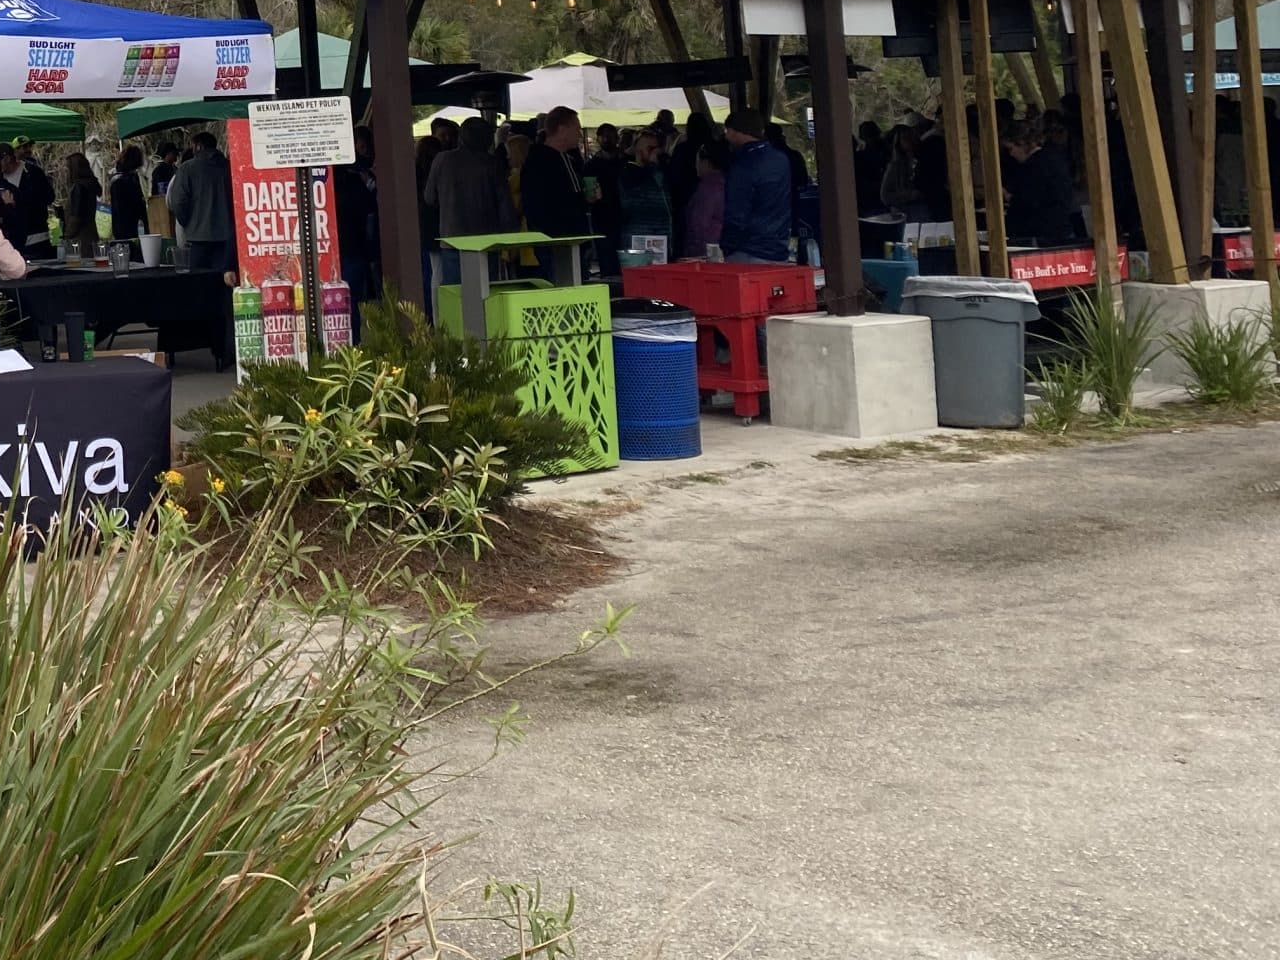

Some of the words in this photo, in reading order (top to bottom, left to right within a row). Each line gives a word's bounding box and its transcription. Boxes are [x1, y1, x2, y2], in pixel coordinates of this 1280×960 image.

[29, 40, 48, 48] BUD
[49, 41, 76, 50] LIGHT
[27, 49, 74, 68] SELTZER
[216, 46, 251, 65] SELTZER
[27, 68, 69, 82] HARD
[217, 65, 249, 78] HARD
[24, 81, 65, 94] SODA
[214, 77, 247, 90] SODA
[256, 103, 281, 112] WEKIVA
[281, 101, 305, 110] ISLAND
[306, 100, 318, 109] PET
[319, 99, 341, 108] POLICY
[243, 181, 297, 212] DARE
[245, 210, 329, 243] SELTZR
[248, 241, 331, 257] DIFFERELY
[1015, 268, 1034, 279] This
[1035, 265, 1056, 277] Bud's
[1058, 264, 1069, 275] For
